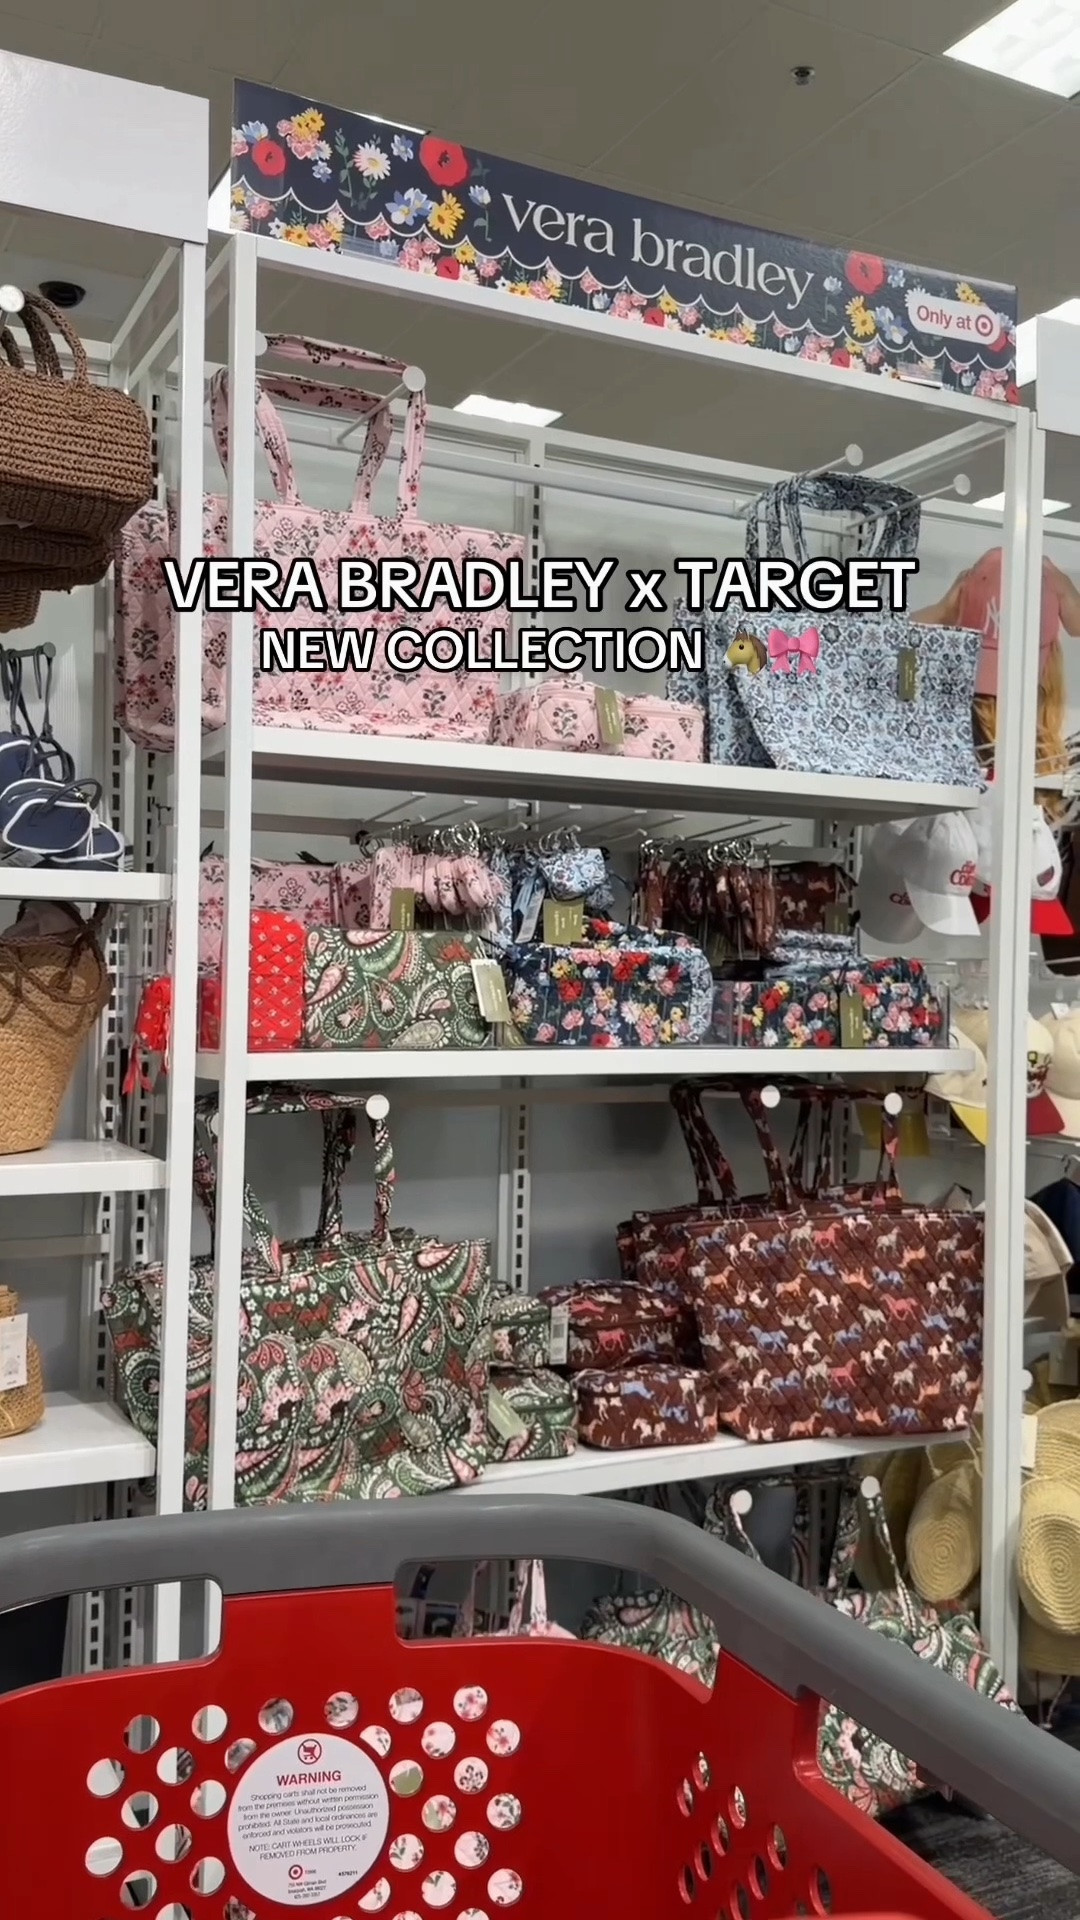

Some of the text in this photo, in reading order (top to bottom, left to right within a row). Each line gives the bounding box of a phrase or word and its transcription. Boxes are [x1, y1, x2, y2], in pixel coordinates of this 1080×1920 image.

[501, 193, 815, 310] vera bradley
[917, 305, 972, 330] Only at
[276, 1770, 342, 1786] WARNING
[251, 1793, 282, 1801] Shopping
[283, 1790, 300, 1798] carts
[301, 1788, 316, 1796] shall
[317, 1787, 328, 1795] not
[338, 1784, 367, 1793] removed
[238, 1804, 253, 1812] from
[266, 1801, 296, 1810] premises
[296, 1798, 320, 1806] without
[321, 1796, 343, 1804] written
[344, 1793, 379, 1802] permission
[243, 1813, 258, 1821] from
[294, 1805, 337, 1815] Unauthorized
[337, 1803, 374, 1812] possession
[282, 1818, 300, 1826] State
[301, 1816, 314, 1824] and
[331, 1812, 366, 1821] ordinances
[242, 1831, 271, 1840] enforced
[286, 1826, 313, 1835] violators
[314, 1824, 324, 1832] will
[325, 1823, 335, 1831] be
[249, 1844, 270, 1852] NOTE:
[271, 1840, 291, 1850] CART
[292, 1838, 322, 1848] WHEELS
[322, 1835, 340, 1844] WILL
[341, 1833, 361, 1843] LOCK
[259, 1849, 295, 1861] REMOVED
[296, 1846, 318, 1857] FROM
